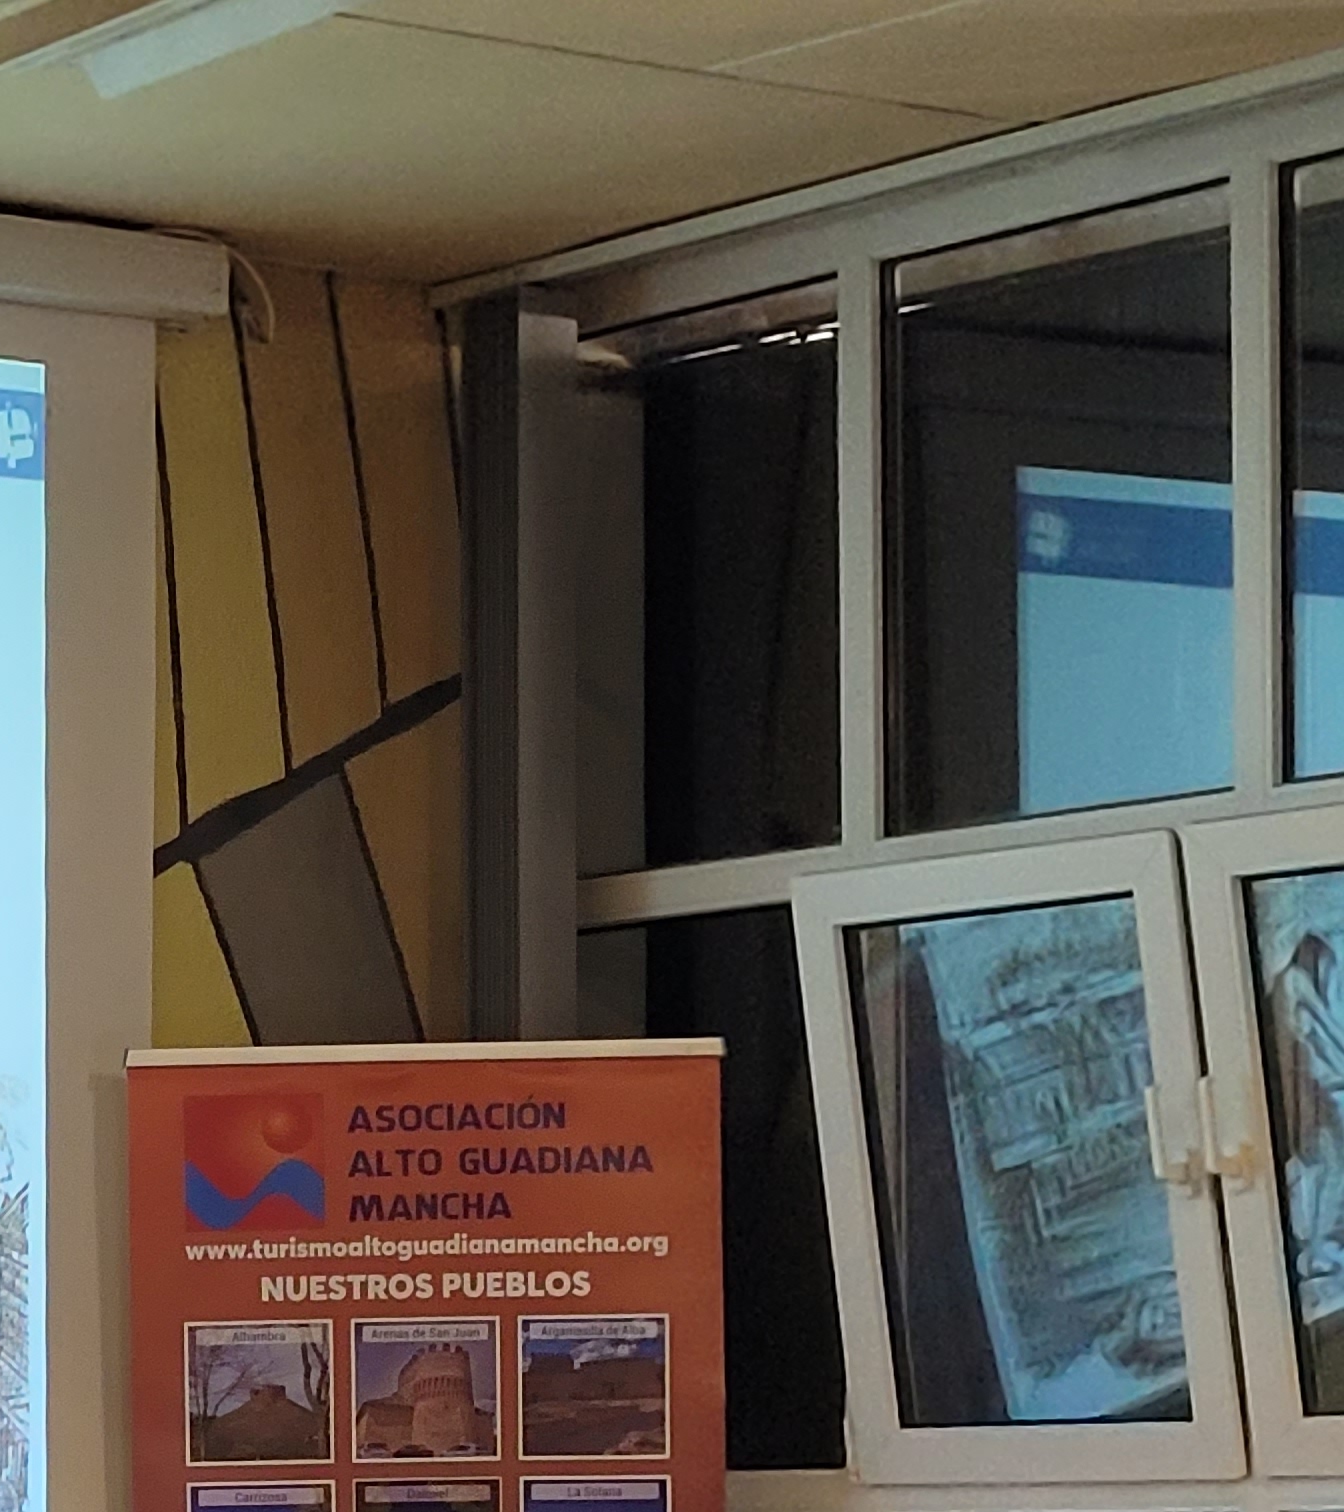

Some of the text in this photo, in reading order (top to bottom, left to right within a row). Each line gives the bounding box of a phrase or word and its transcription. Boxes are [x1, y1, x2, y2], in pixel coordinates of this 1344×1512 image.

[347, 1095, 566, 1134] ASOCIACIÓN
[347, 1145, 654, 1179] ALTO GUADIANA
[348, 1191, 512, 1223] MANCHA
[185, 1231, 669, 1263] www.turismoaltoguadianamancha.org
[261, 1270, 592, 1303] NUESTROS PUEBLOS
